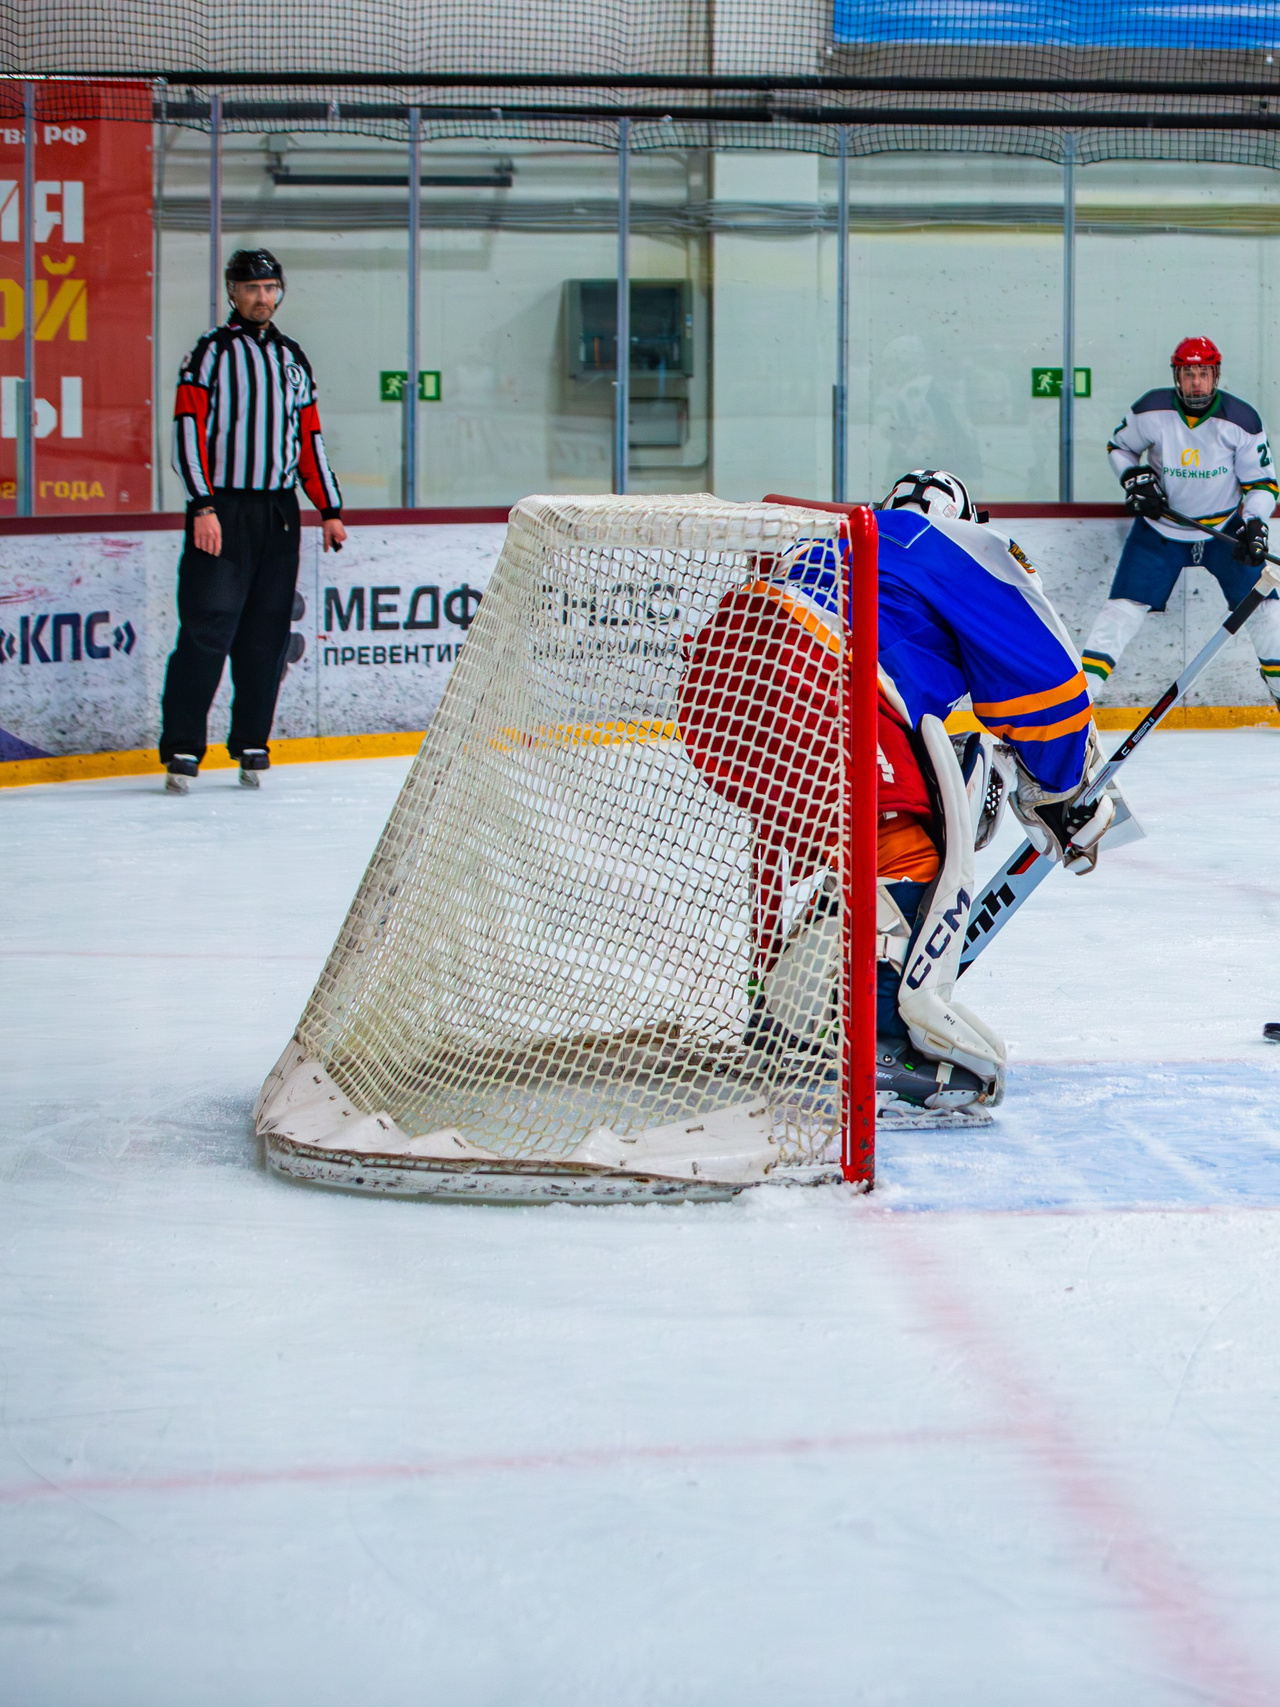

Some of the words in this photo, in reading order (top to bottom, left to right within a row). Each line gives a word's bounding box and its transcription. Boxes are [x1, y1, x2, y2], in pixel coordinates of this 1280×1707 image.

[40, 481, 105, 500] ГОДА
[1121, 721, 1151, 756] CYBER
[906, 887, 971, 990] CCM
